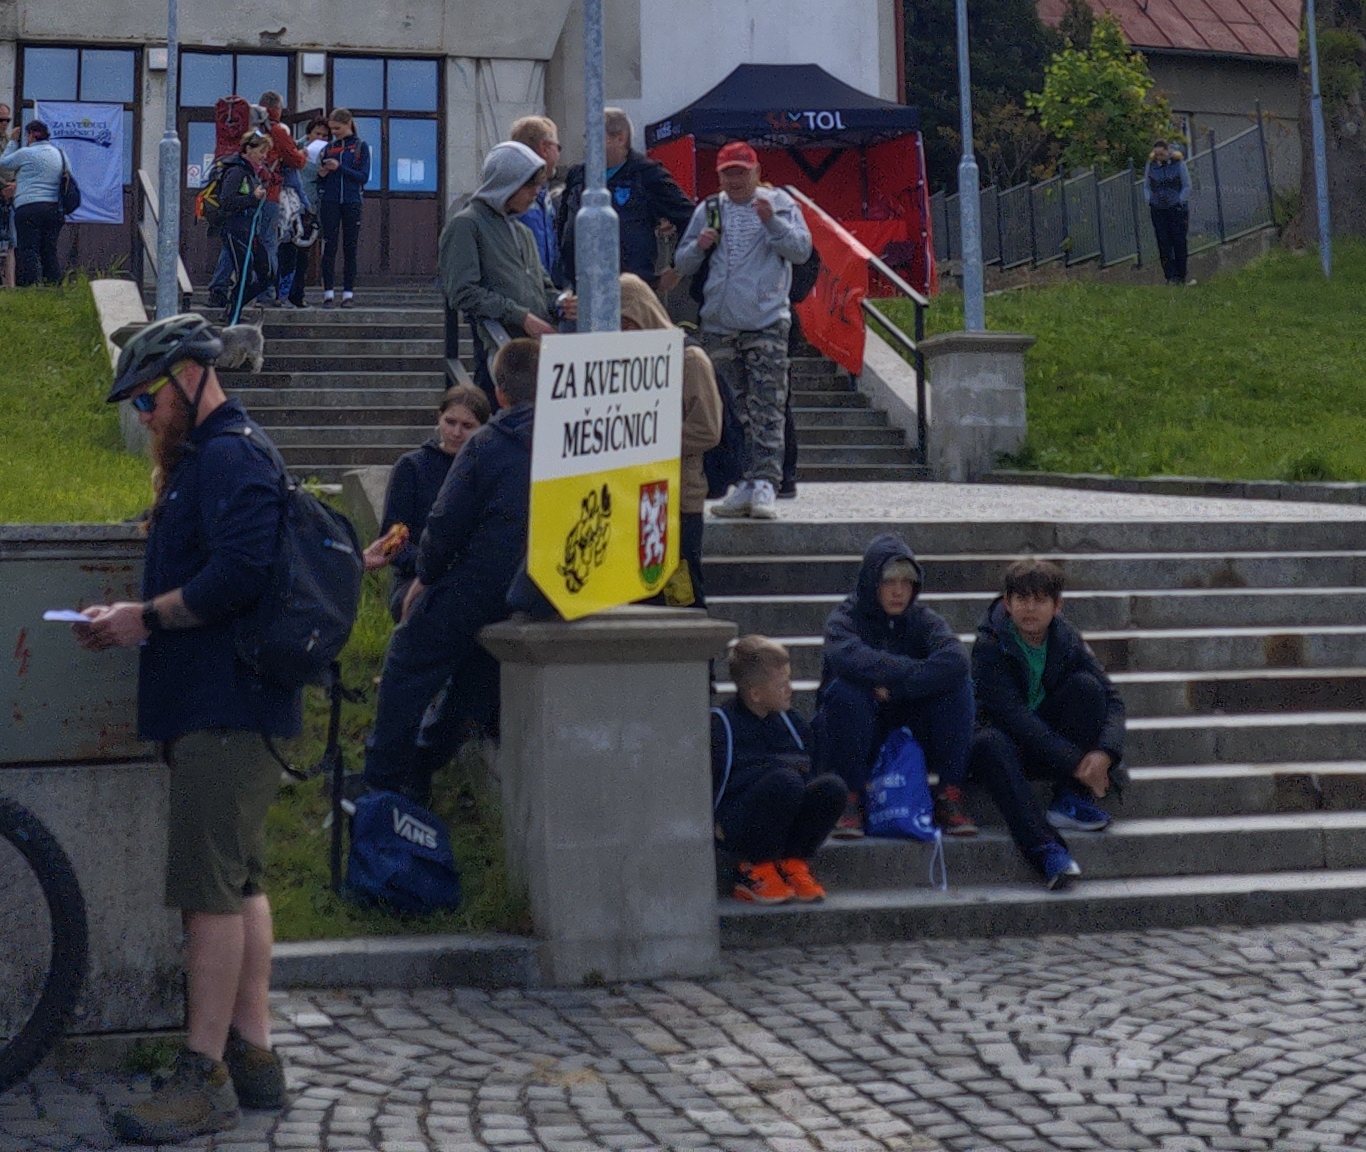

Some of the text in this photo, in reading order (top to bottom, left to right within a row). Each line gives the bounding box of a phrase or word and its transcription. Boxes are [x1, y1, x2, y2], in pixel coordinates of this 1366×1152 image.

[551, 344, 671, 400] ZA KVETOUCÍ
[561, 399, 659, 458] MĚSÍČNICÍ
[393, 807, 438, 849] VANS
